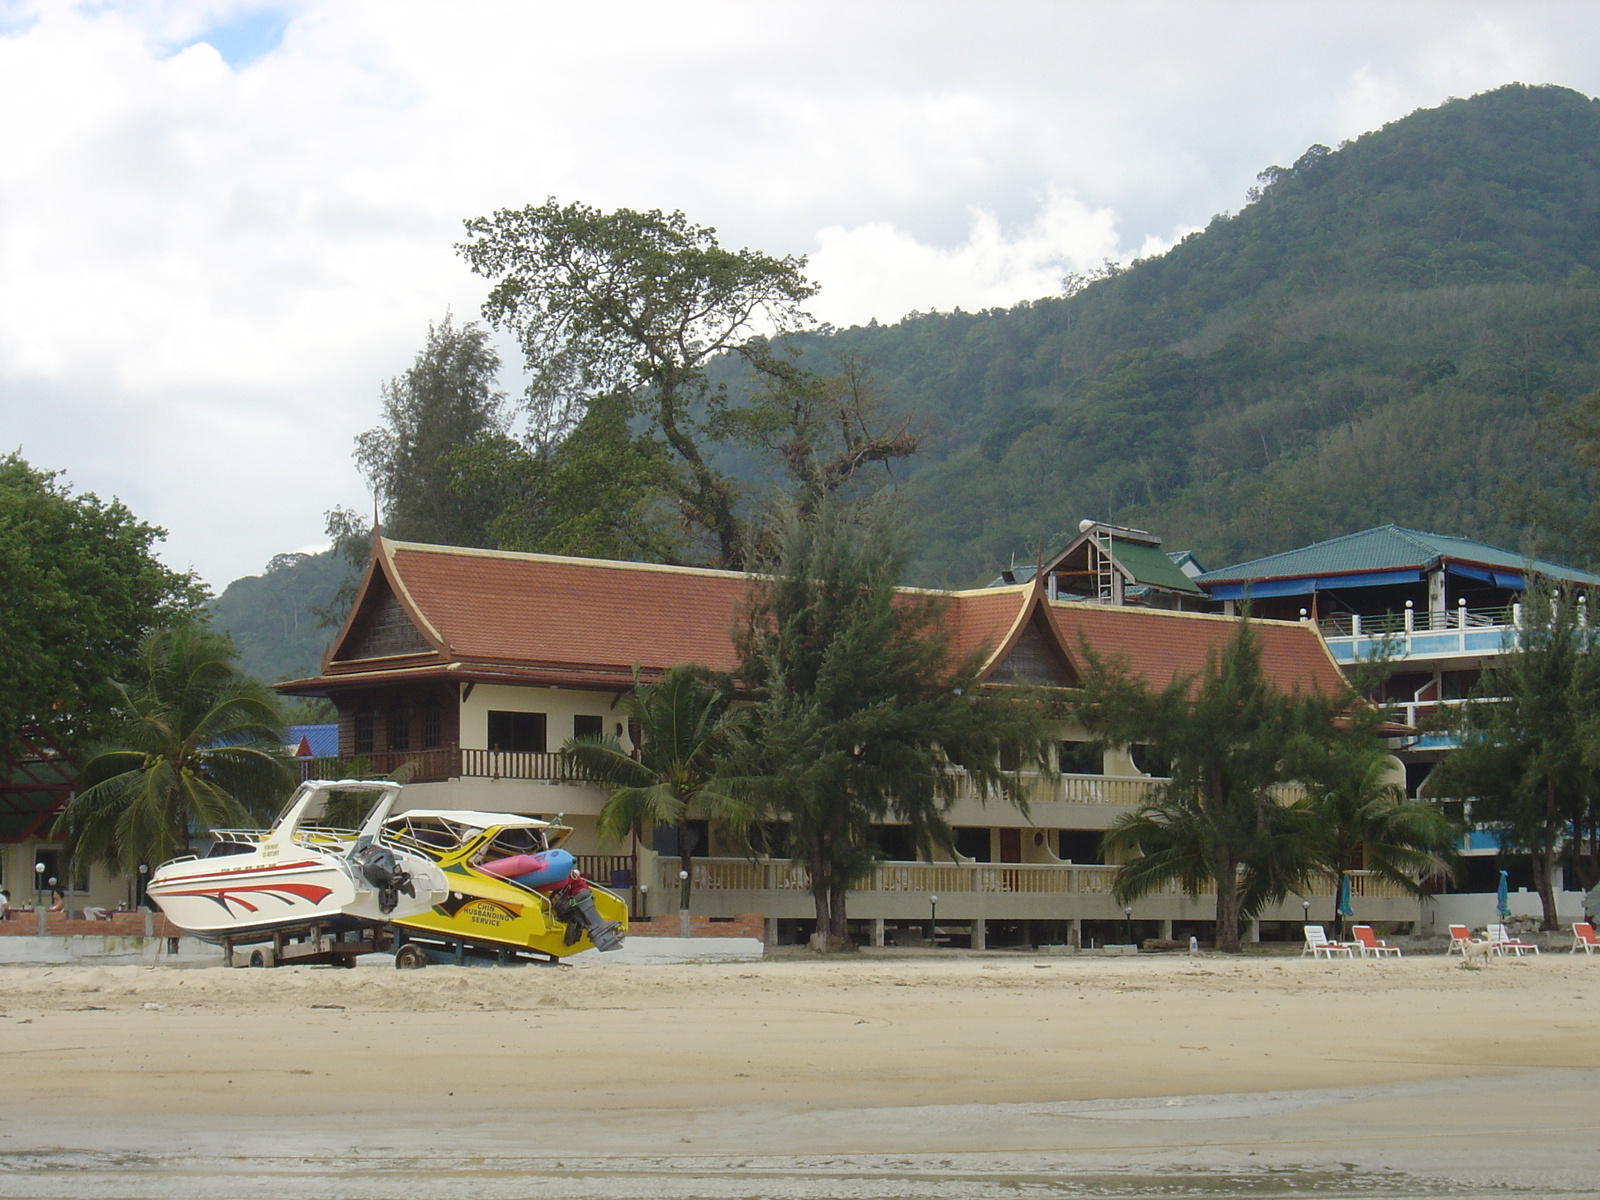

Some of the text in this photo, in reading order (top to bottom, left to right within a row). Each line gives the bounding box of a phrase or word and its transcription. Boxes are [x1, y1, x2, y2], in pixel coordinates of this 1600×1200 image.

[477, 903, 495, 912] CHIN
[463, 907, 510, 922] HUSBANDING
[471, 916, 501, 927] SERVICE
